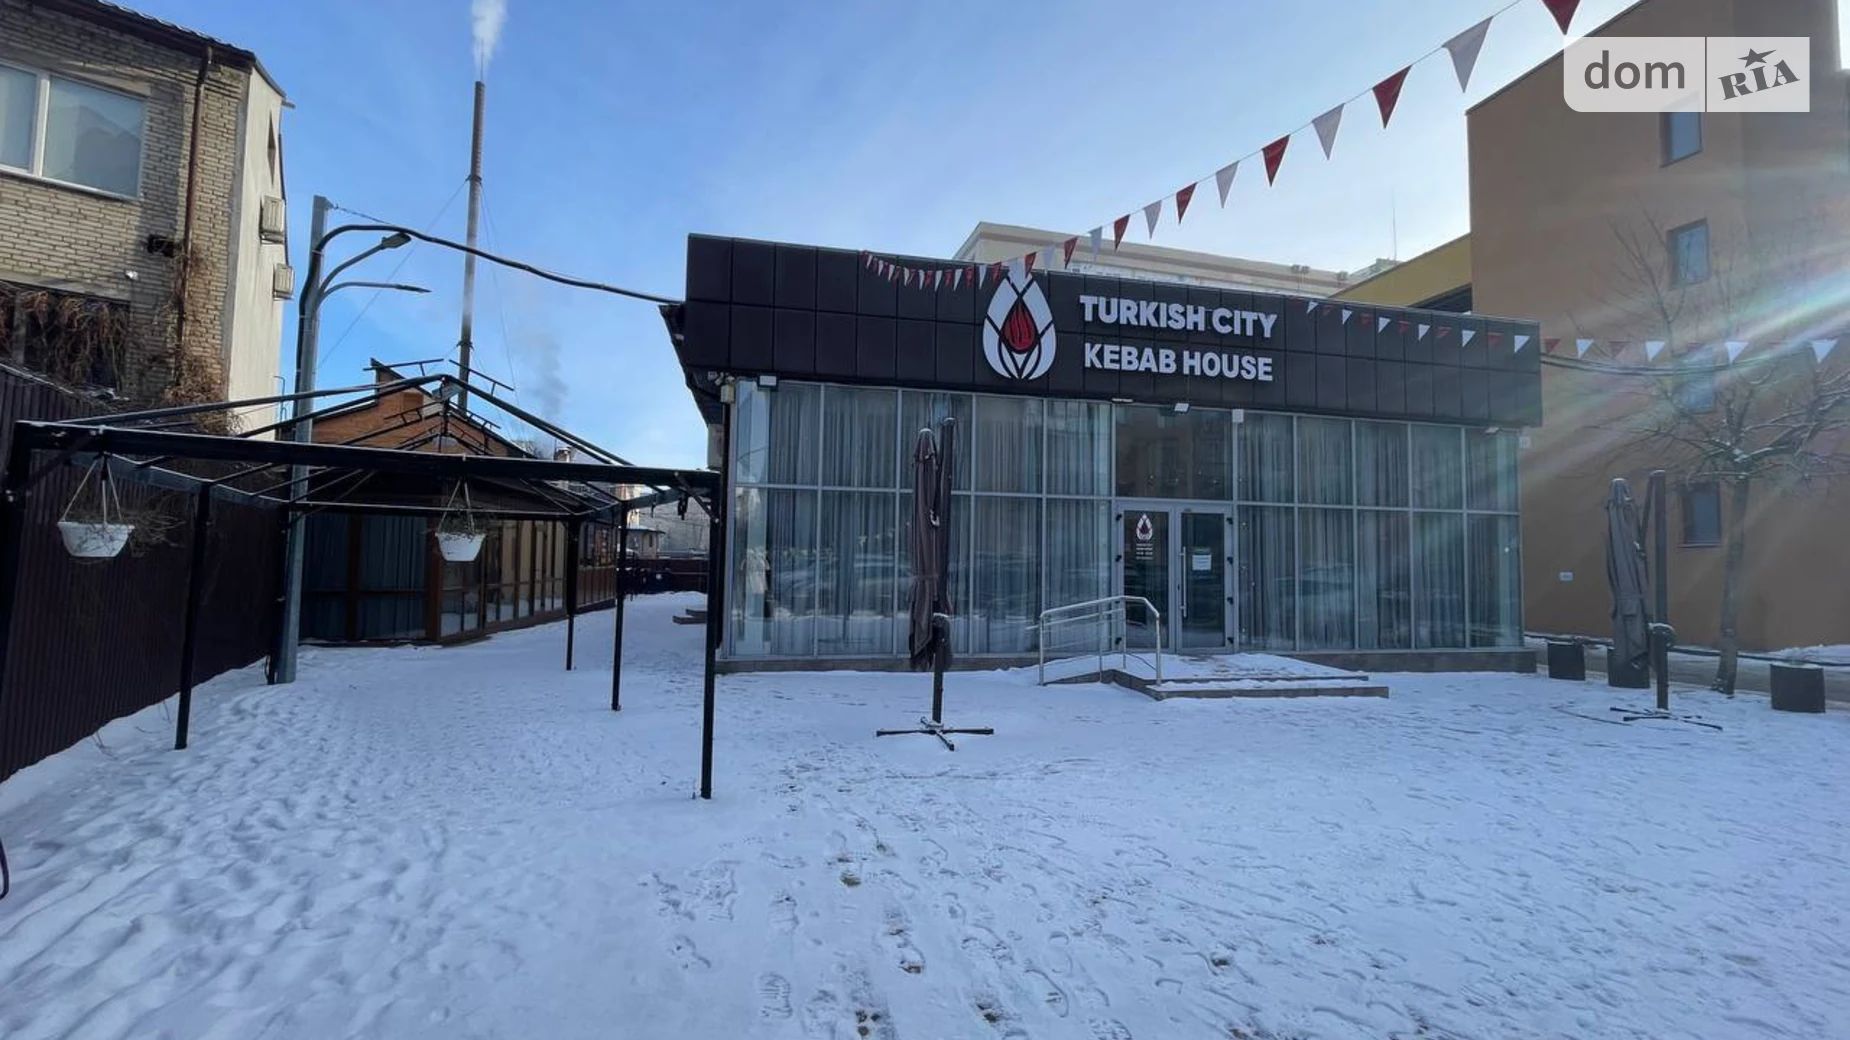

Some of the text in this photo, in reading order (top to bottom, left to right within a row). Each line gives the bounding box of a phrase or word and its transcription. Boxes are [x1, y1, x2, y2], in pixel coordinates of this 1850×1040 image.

[1079, 295, 1278, 338] TURKISH CITY
[1084, 343, 1274, 382] KEBAB HOUSE
